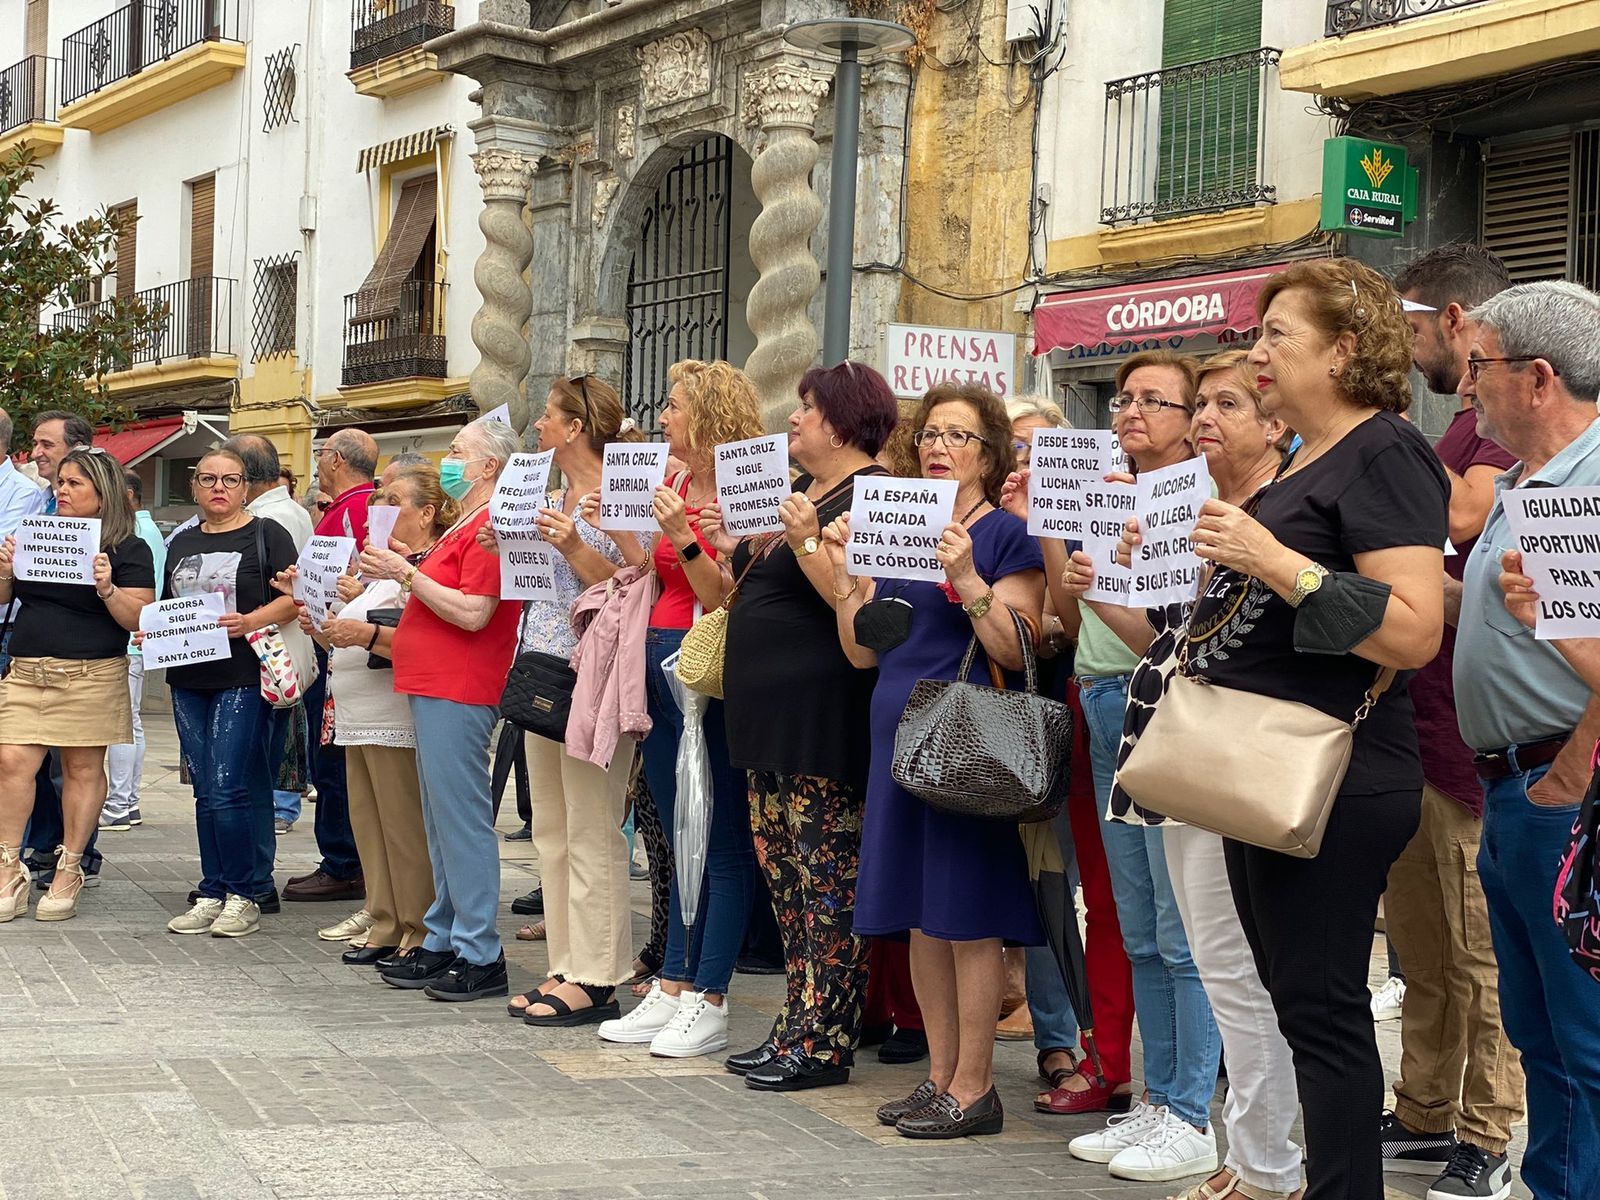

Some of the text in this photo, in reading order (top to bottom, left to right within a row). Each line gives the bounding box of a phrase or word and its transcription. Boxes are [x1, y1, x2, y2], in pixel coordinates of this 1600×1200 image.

[1348, 188, 1402, 205] CAJA RURAL
[1364, 213, 1394, 226] ServiRed
[1106, 293, 1225, 331] CÓRDOBA
[904, 332, 999, 363] PRENSA
[894, 365, 1007, 396] REVISTAS
[1038, 436, 1068, 448] DESDE
[1071, 437, 1100, 451] 1996,
[720, 442, 776, 461] SANTA CRUZ
[606, 453, 659, 468] SANTA CRUZ,
[1037, 456, 1100, 470] SANTA CRUZ
[736, 462, 763, 476] SIGUE
[522, 472, 540, 482] SIGUE
[1042, 477, 1095, 490] LUCHAN
[610, 478, 649, 492] BARRIADA
[721, 478, 784, 496] RECLAMANDO
[1151, 473, 1196, 500] AUCORSA
[729, 496, 780, 513] PROMESAS
[864, 489, 938, 505] LA ESPAÑA
[1033, 497, 1052, 510] POR
[602, 504, 612, 517] DE
[625, 501, 654, 518] DIVISIÓ
[1146, 504, 1196, 529] NO LLEGA,
[22, 519, 91, 531] SANTA CRUZ,
[728, 515, 785, 530] INCUMPLIDA
[868, 511, 926, 526] VACIADA
[33, 532, 78, 542] IGUALES
[311, 540, 338, 548] AUCORSA
[854, 530, 884, 546] ESTÁ
[890, 535, 899, 546] A
[24, 544, 88, 556] IMPUESTOS,
[1172, 537, 1198, 554] CRU
[33, 557, 78, 567] IGUALES
[508, 551, 549, 566] QUIERE SU
[853, 553, 872, 566] DE
[26, 569, 83, 580] SERVICIOS
[514, 573, 552, 589] AUTOBÚS
[1136, 572, 1168, 592] SIGUE
[1549, 568, 1594, 588] PARA
[158, 599, 204, 612] AUCORSA
[1541, 600, 1600, 620] LOS CO
[168, 613, 197, 624] SIGUE
[158, 648, 216, 664] SANTA CRUZ
